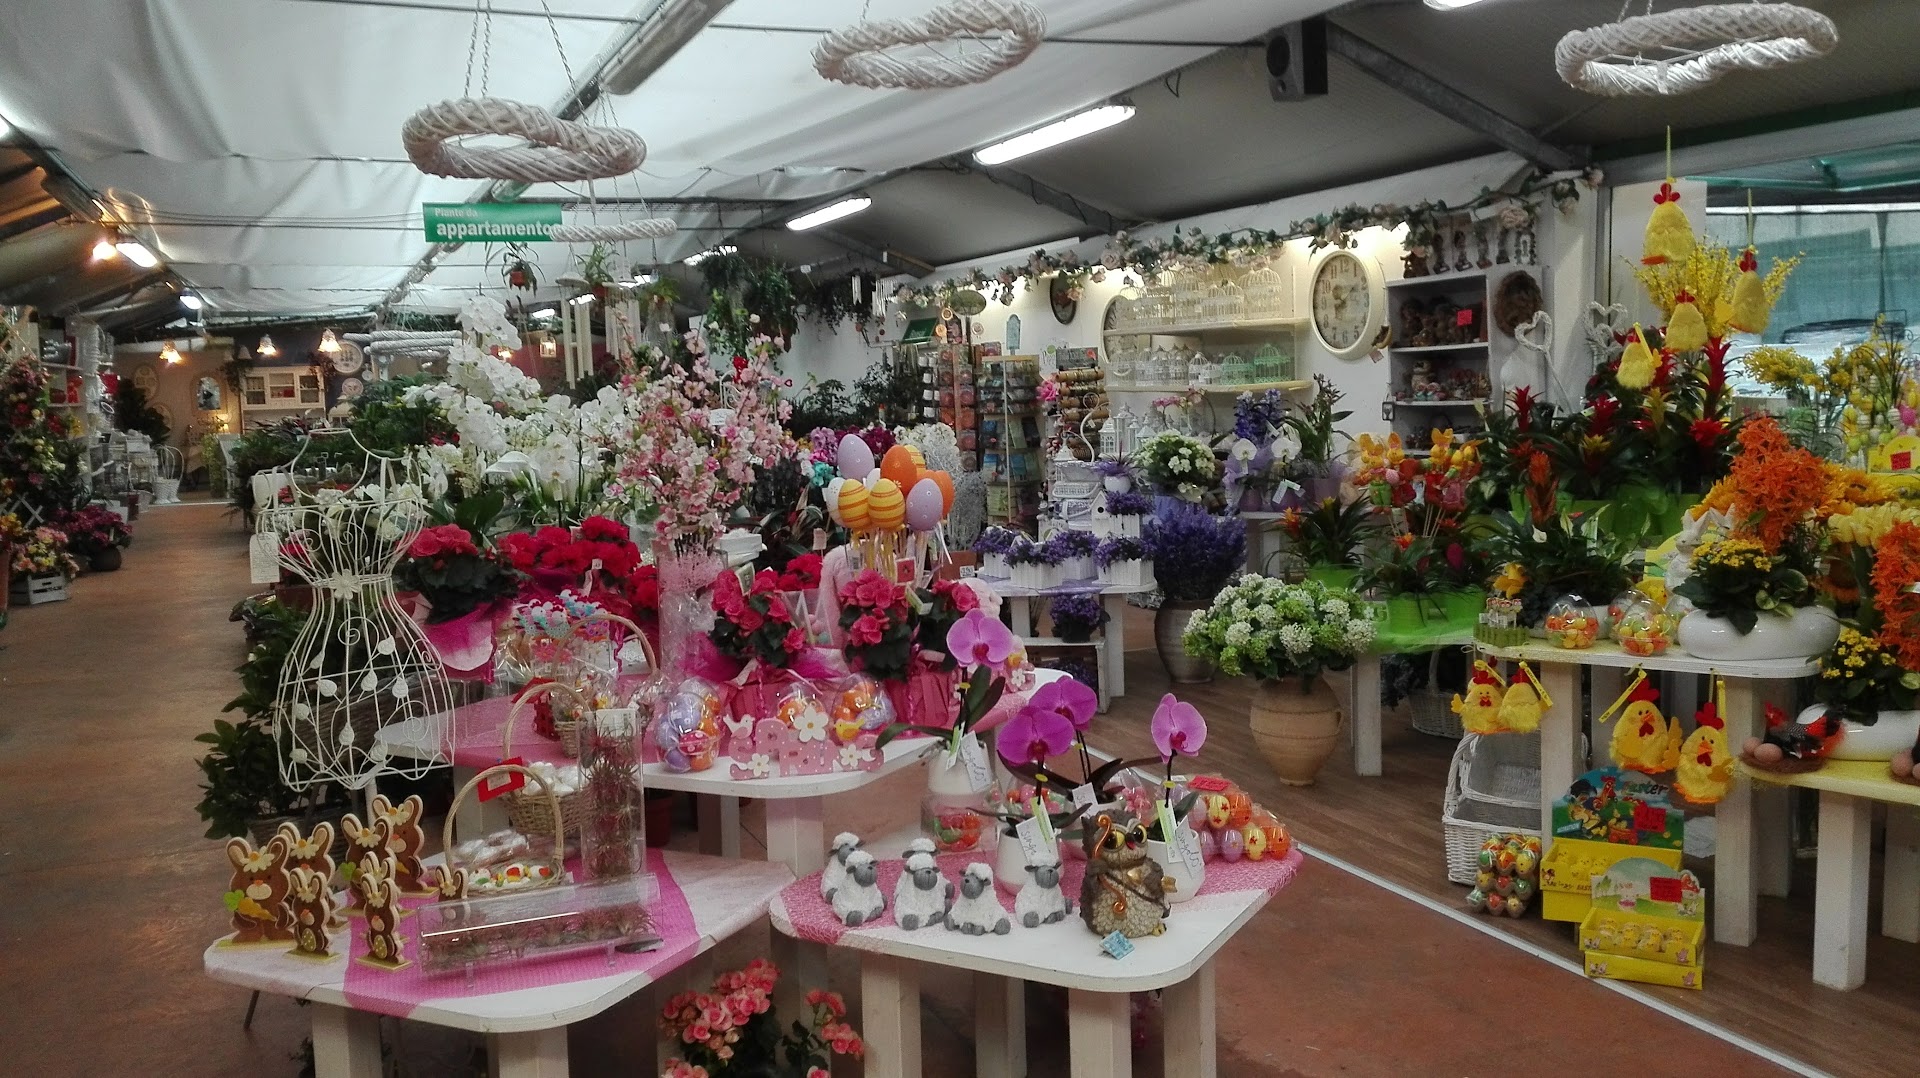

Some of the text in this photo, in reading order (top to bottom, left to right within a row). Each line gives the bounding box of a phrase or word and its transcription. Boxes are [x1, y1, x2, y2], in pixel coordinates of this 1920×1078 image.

[434, 207, 464, 217] Piante
[436, 220, 552, 240] appartamento
[1340, 259, 1349, 273] 12
